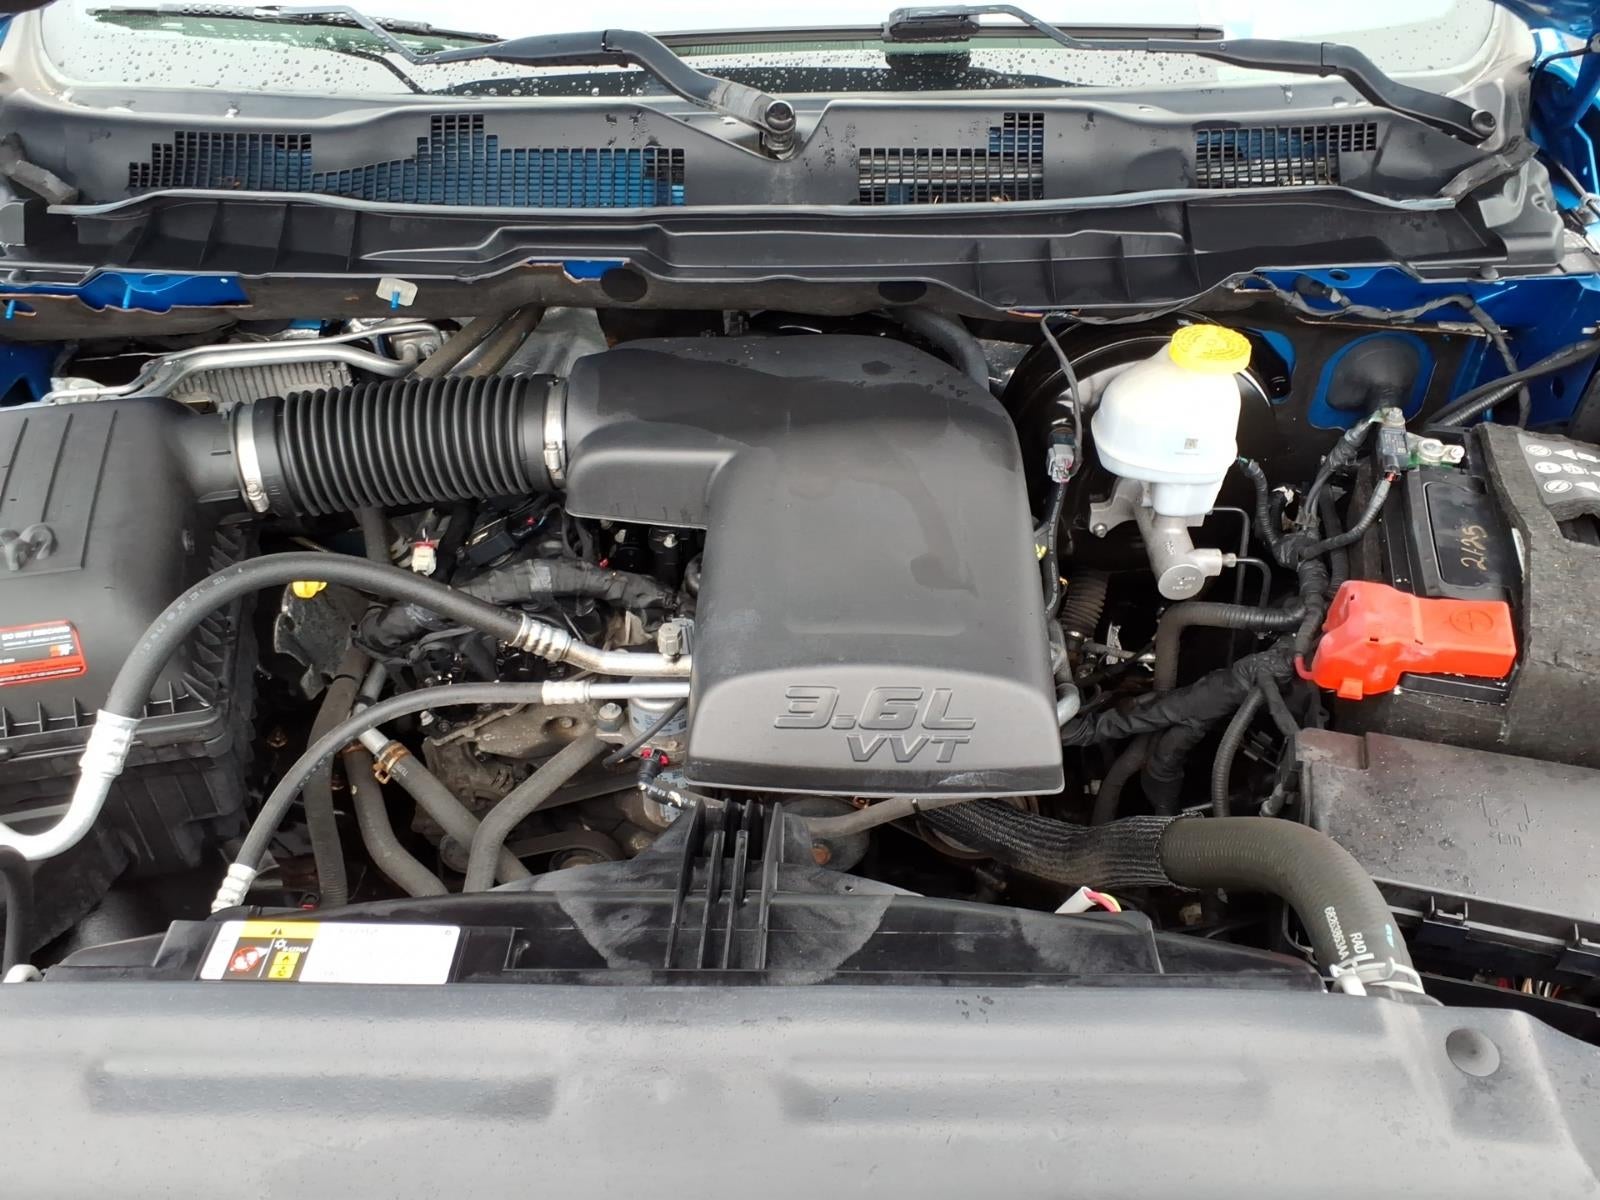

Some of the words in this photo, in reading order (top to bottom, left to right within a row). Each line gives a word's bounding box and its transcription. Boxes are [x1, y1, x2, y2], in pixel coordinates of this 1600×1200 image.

[774, 686, 977, 731] 3.6L
[846, 735, 971, 763] VVT
[1350, 932, 1367, 954] RAD
